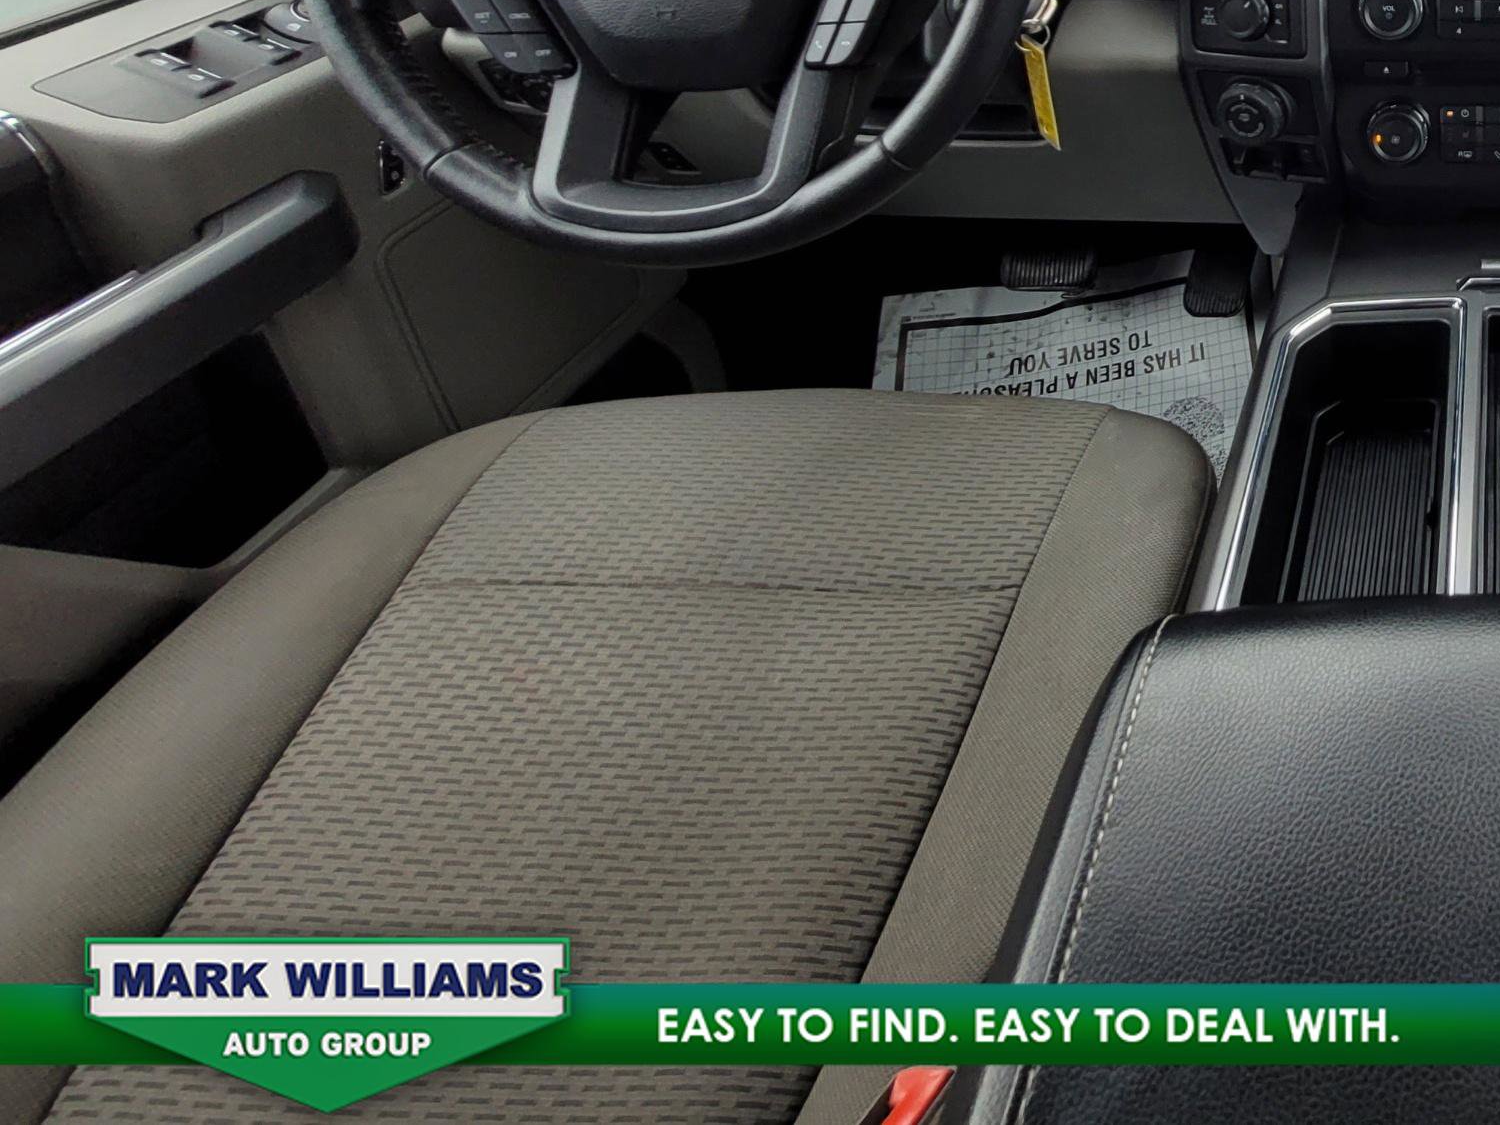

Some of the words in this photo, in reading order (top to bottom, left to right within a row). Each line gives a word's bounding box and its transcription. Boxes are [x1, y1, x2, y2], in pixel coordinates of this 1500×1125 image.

[1129, 330, 1152, 350] TO
[1009, 352, 1050, 375] YOU
[1057, 338, 1120, 366] SERVE
[1143, 348, 1181, 374] HAS
[1188, 342, 1205, 362] IT
[1066, 373, 1079, 389] A
[1086, 360, 1135, 386] BEEN
